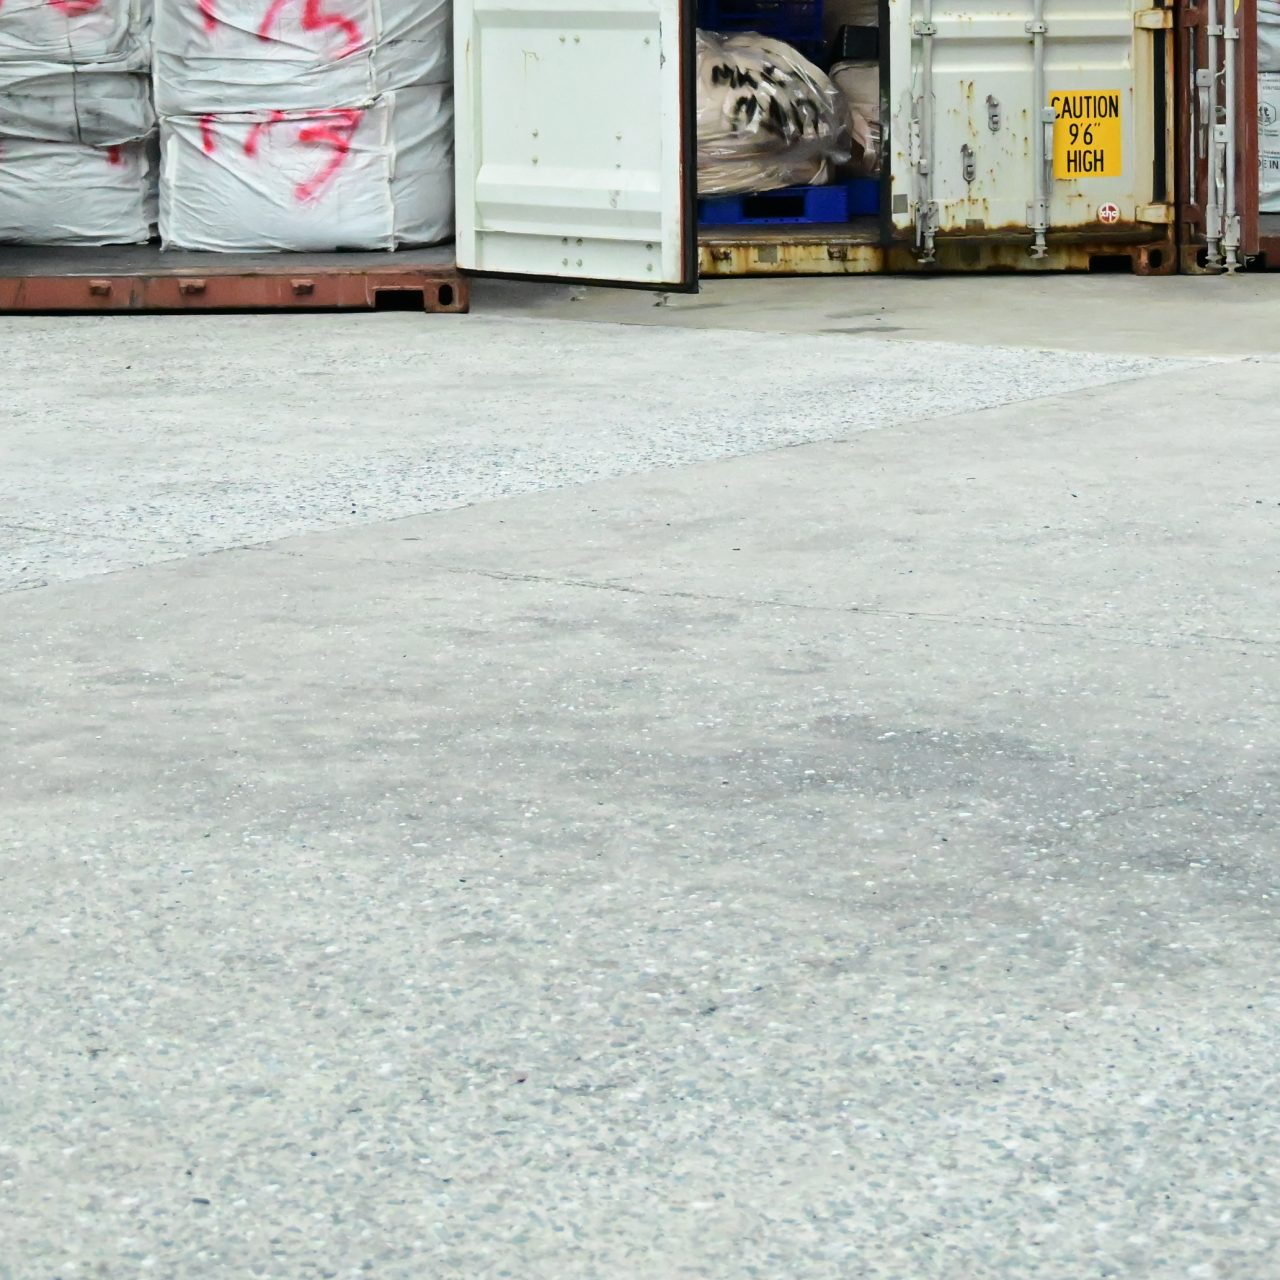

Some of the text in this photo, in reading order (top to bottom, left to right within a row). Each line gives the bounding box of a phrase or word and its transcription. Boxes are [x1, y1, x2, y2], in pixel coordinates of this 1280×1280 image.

[1052, 94, 1119, 120] CAUTION
[1066, 149, 1105, 173] HIGH
[1269, 160, 1279, 170] IN
